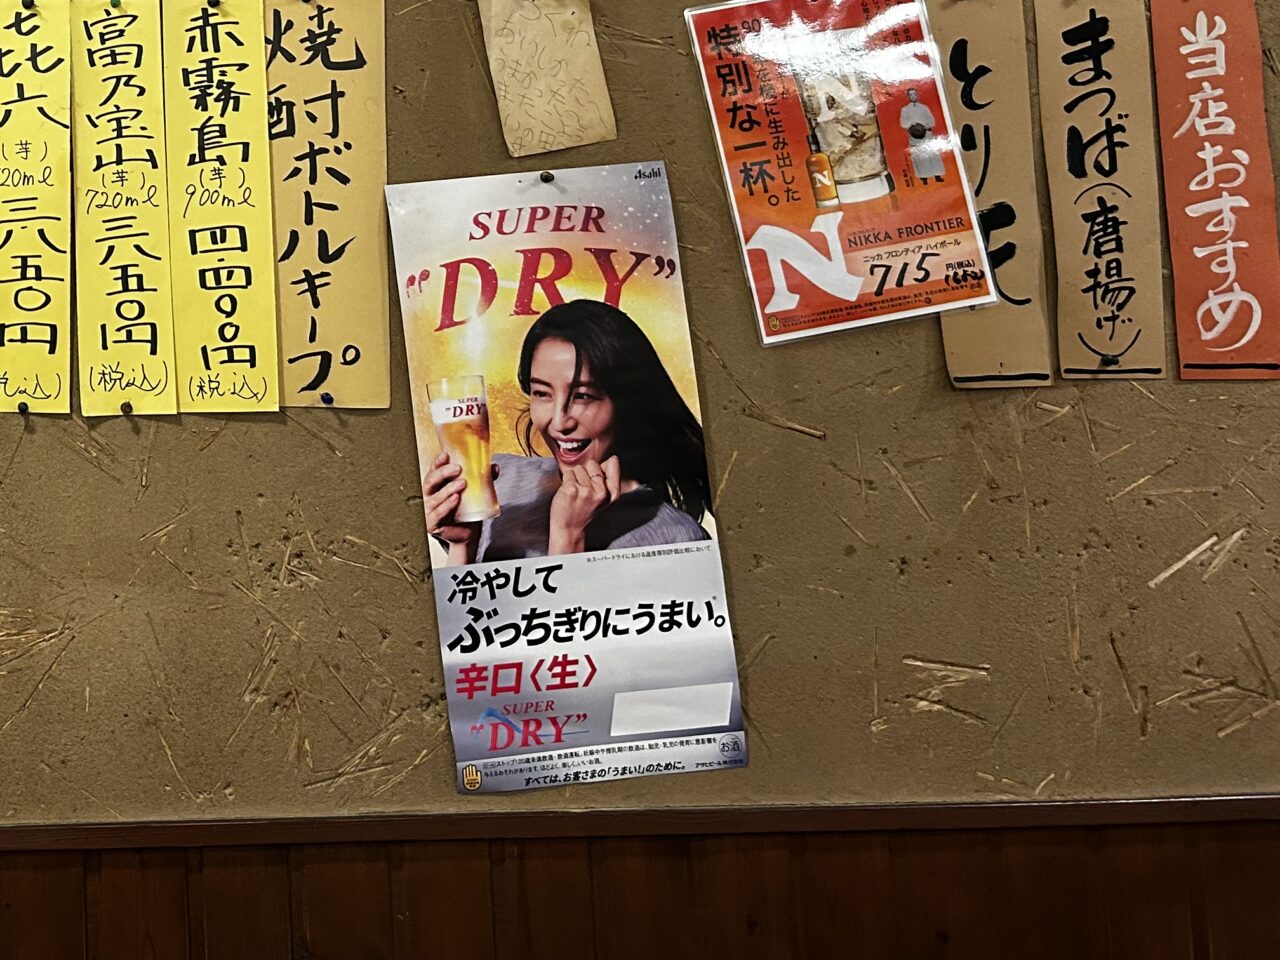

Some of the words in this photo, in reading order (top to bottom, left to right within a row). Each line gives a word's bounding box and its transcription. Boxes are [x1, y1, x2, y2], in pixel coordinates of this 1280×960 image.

[83, 9, 158, 172] 富乃宝山
[182, 8, 251, 166] 赤霧島
[706, 23, 780, 207] 特別な一杯。
[2, 140, 47, 161] (芋)
[102, 170, 145, 189] (芋)
[200, 167, 245, 189] (芋)
[634, 167, 662, 180] Asahi
[1173, 10, 1262, 353] 当店おすすめ
[265, 5, 367, 393] 焼酎ボトルキープ
[469, 205, 606, 241] SUPER
[847, 230, 893, 248] NIKKA
[897, 216, 966, 239] FRONTIER
[745, 211, 864, 314] N
[870, 253, 940, 297] 715
[90, 361, 167, 396] (税込)
[189, 373, 267, 402] (税込)
[447, 563, 564, 605] 冷やして
[502, 699, 556, 716] SUPER
